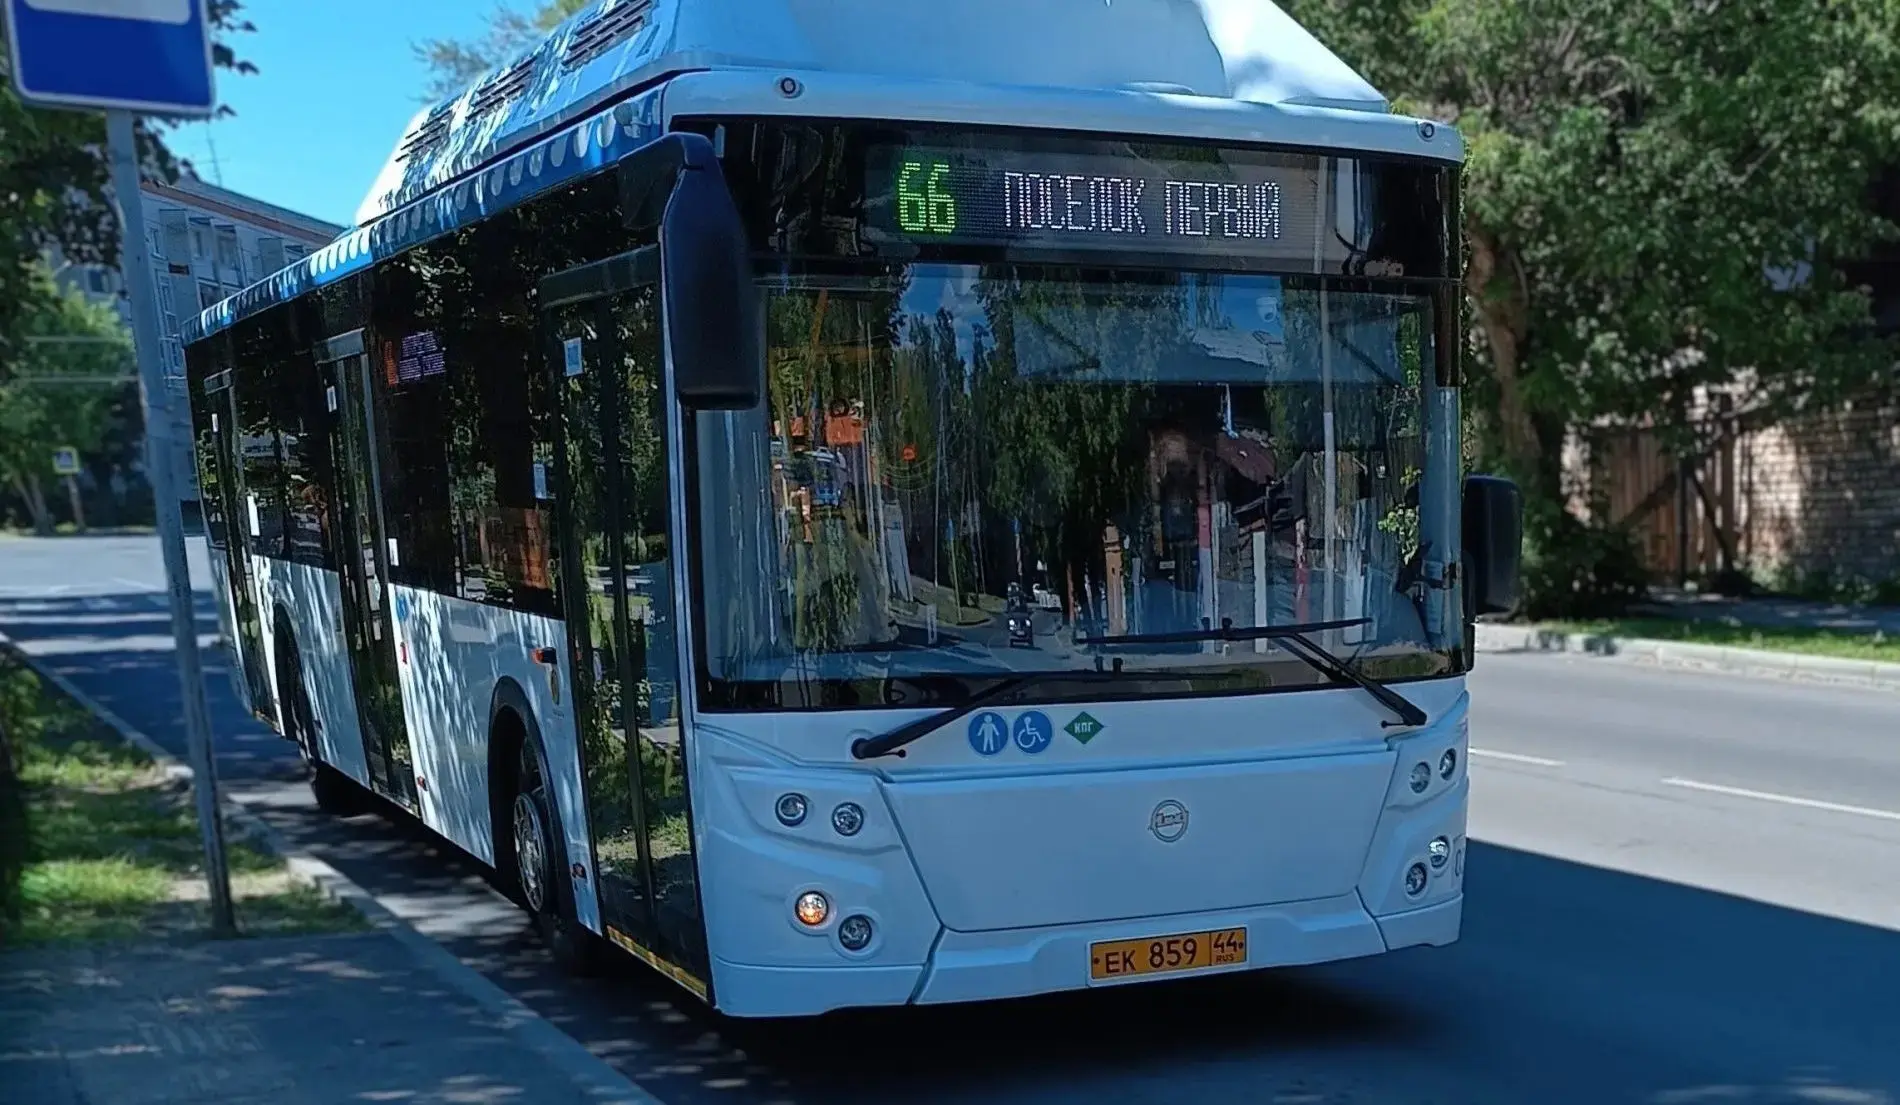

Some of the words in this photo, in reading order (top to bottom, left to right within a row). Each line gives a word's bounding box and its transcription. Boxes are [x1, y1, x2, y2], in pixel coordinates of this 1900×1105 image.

[898, 162, 956, 234] 66
[1004, 172, 1146, 233] ПОСЕЛОК
[1164, 181, 1281, 238] ПЕРВЫЙ
[1074, 722, 1094, 733] КПГ
[1149, 938, 1197, 969] 859
[1213, 932, 1237, 952] 44
[1215, 954, 1234, 963] RUS
